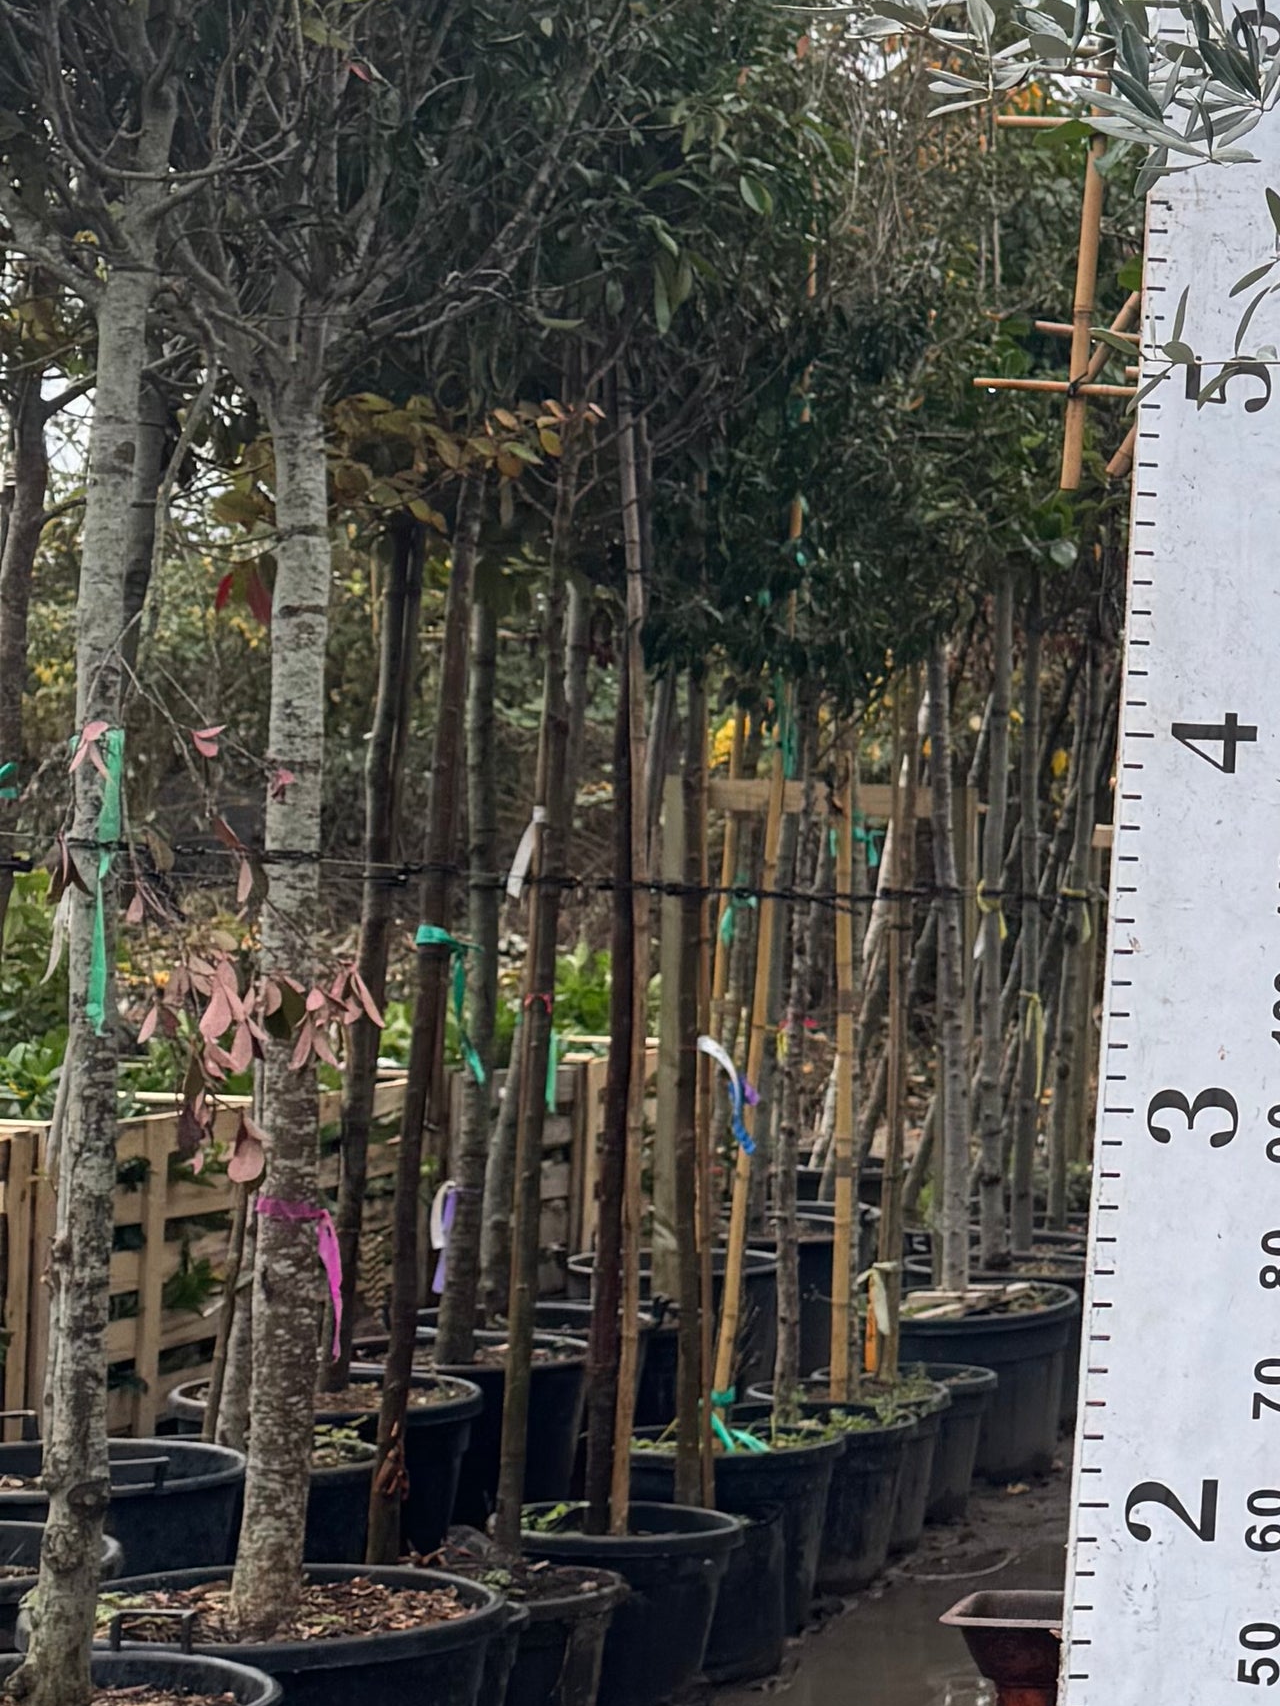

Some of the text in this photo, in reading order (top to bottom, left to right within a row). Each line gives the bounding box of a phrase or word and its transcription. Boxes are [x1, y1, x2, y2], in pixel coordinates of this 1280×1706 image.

[1185, 356, 1272, 413] 5
[1171, 712, 1258, 774] 4
[1147, 1087, 1239, 1149] 3
[1124, 1479, 1219, 1542] 2
